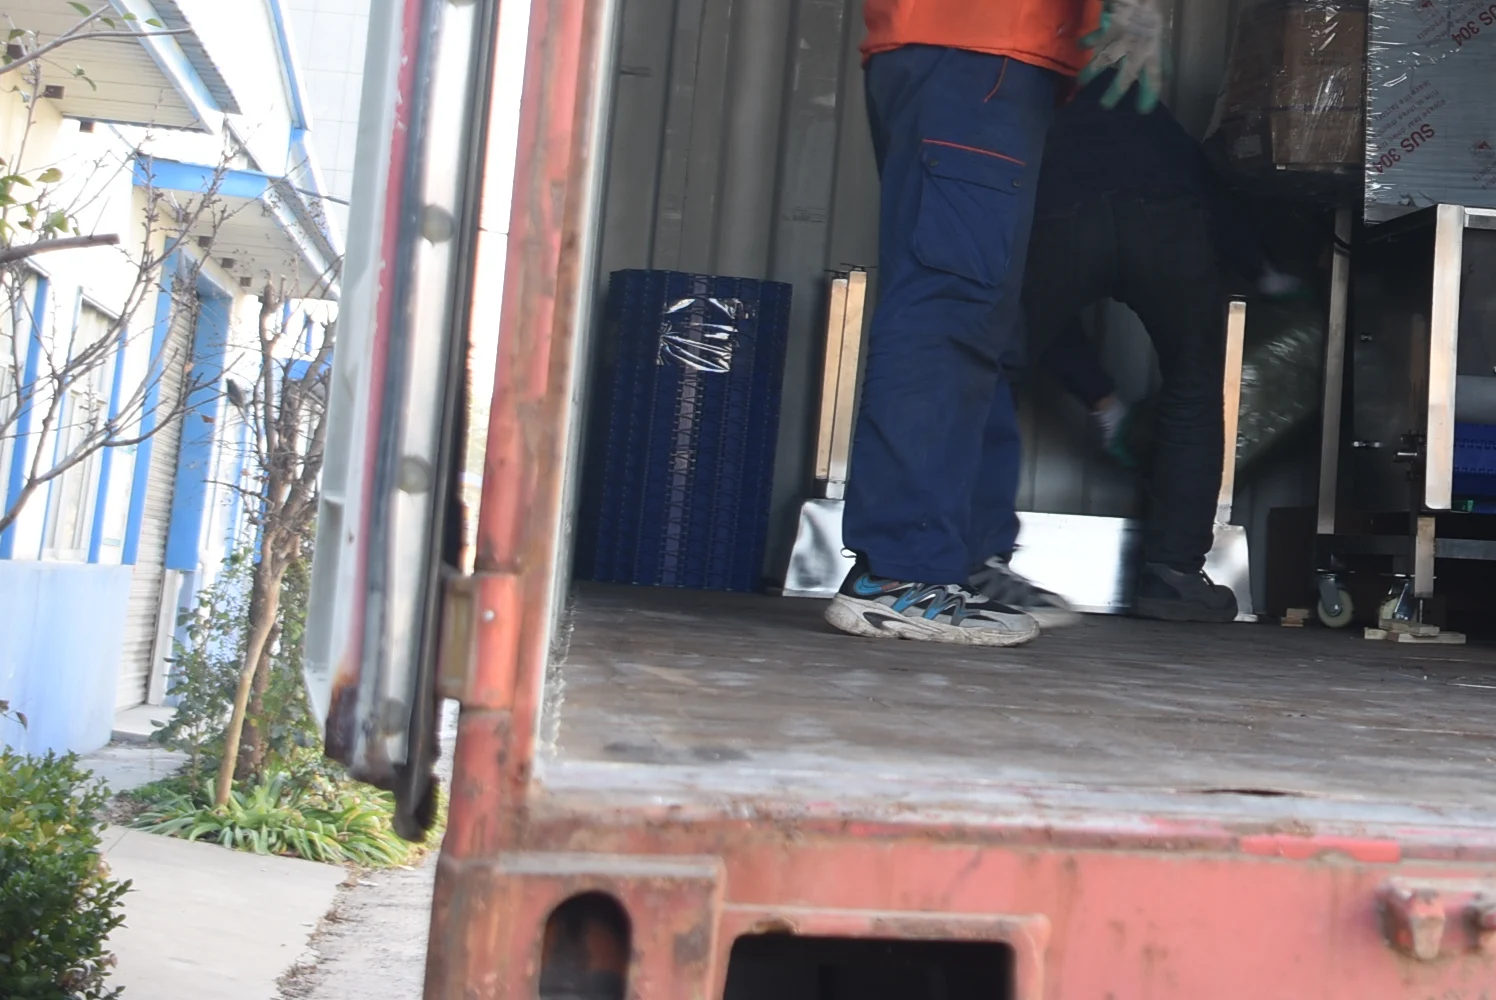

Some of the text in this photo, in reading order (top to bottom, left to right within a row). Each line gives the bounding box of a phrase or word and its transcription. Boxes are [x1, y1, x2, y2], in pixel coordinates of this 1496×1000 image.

[1451, 21, 1479, 45] 304
[1372, 123, 1434, 173] SUS 304
